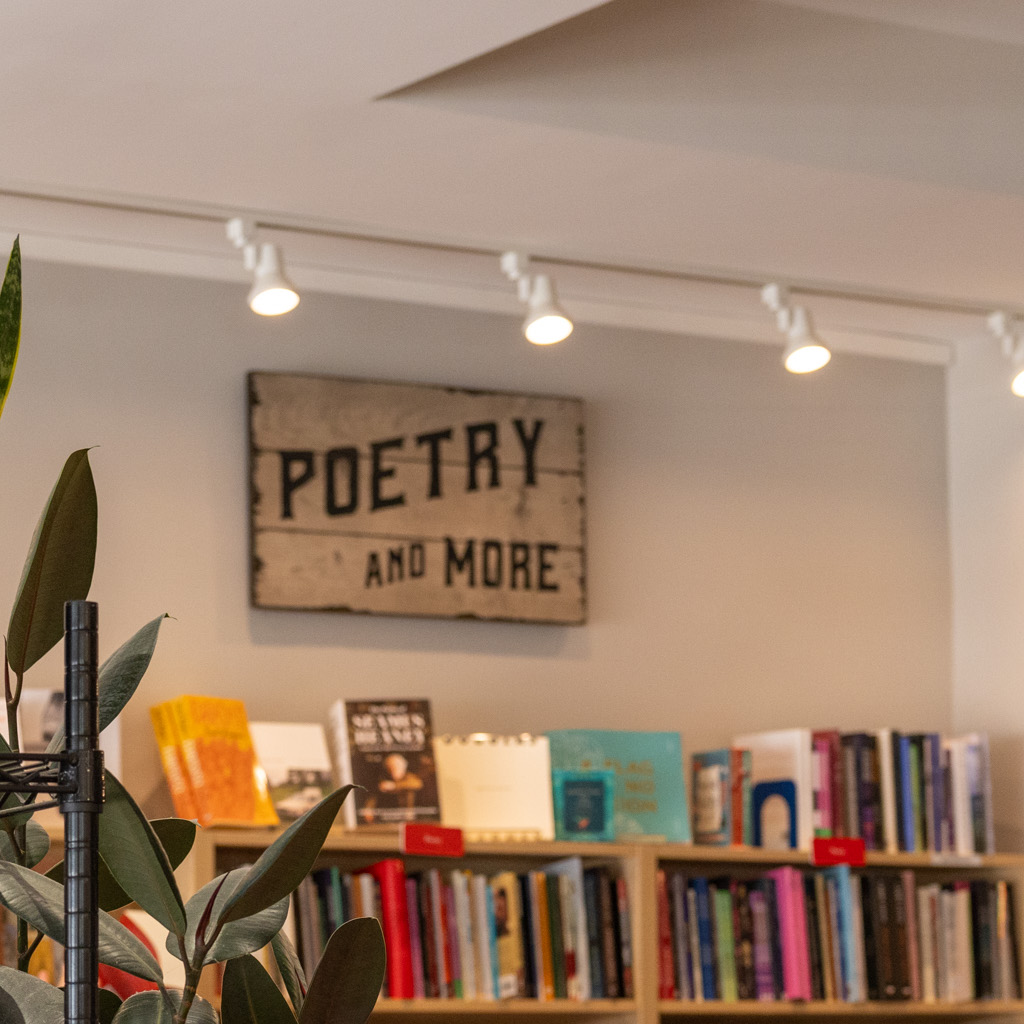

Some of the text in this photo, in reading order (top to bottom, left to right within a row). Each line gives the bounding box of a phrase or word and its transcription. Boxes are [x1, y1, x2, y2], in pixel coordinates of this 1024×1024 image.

[278, 418, 544, 520] POETRY
[364, 536, 561, 592] AND MORE
